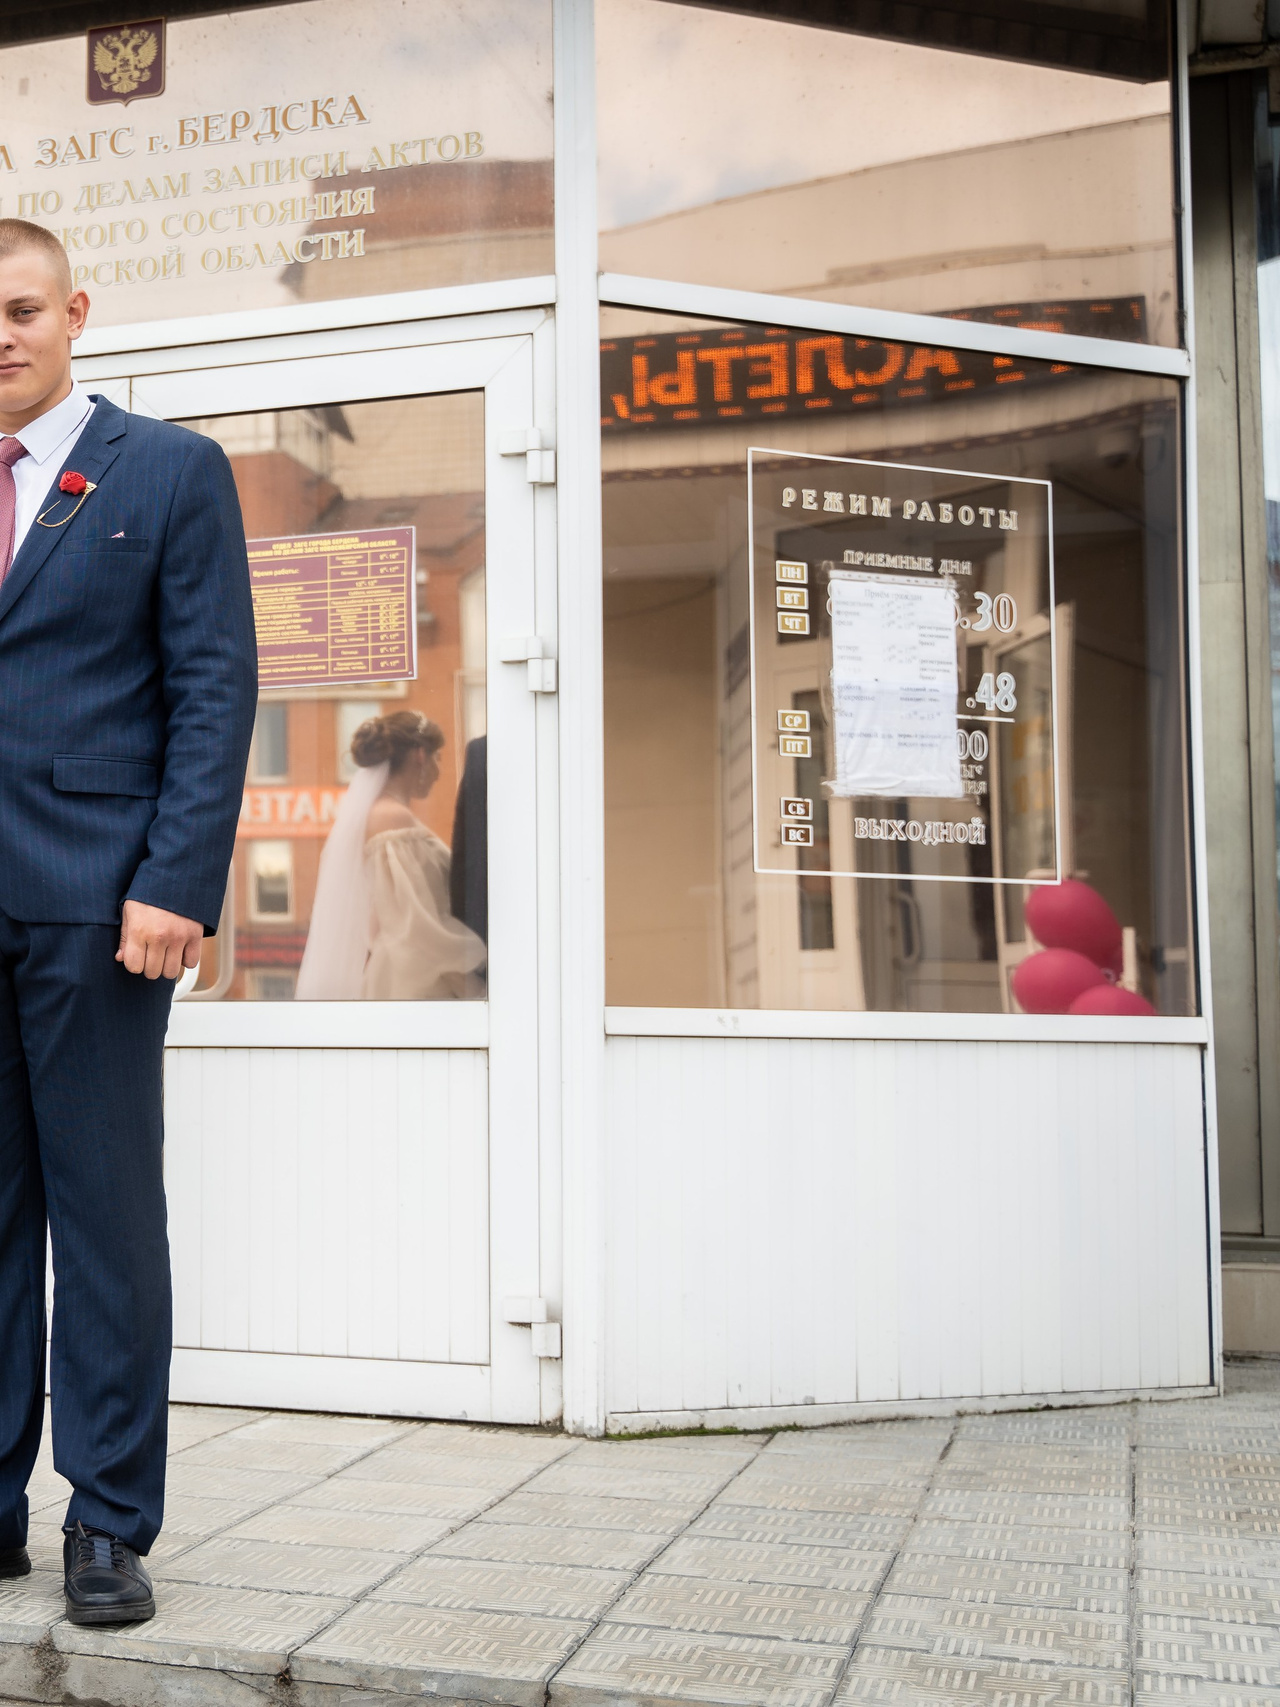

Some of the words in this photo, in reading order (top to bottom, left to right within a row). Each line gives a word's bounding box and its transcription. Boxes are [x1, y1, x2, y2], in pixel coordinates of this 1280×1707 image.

[34, 125, 135, 169] ЗАГС
[146, 134, 171, 155] г.
[177, 93, 370, 151] БЕРДСКА
[16, 188, 63, 218] ПО
[73, 172, 191, 215] ДЕЛАМ
[201, 150, 349, 194] ЗАПИСИ
[360, 131, 484, 174] АКТОВ
[161, 186, 376, 239] СОСТОЯНИЯ
[200, 229, 367, 274] ОБЛАСТИ
[782, 487, 892, 518] РЕЖИМ
[902, 500, 1019, 531] РАБОТЫ
[781, 566, 802, 580] ПН
[843, 550, 934, 572] ПРИЕМНЫЕ
[938, 559, 973, 576] ДНИ
[783, 591, 801, 606] ВТ
[784, 617, 803, 631] ЧТ
[785, 715, 803, 728] СР
[785, 740, 804, 753] ПТ
[788, 803, 806, 816] СБ
[788, 829, 806, 842] ВС
[854, 817, 986, 846] ВЫХОДНОЙ
